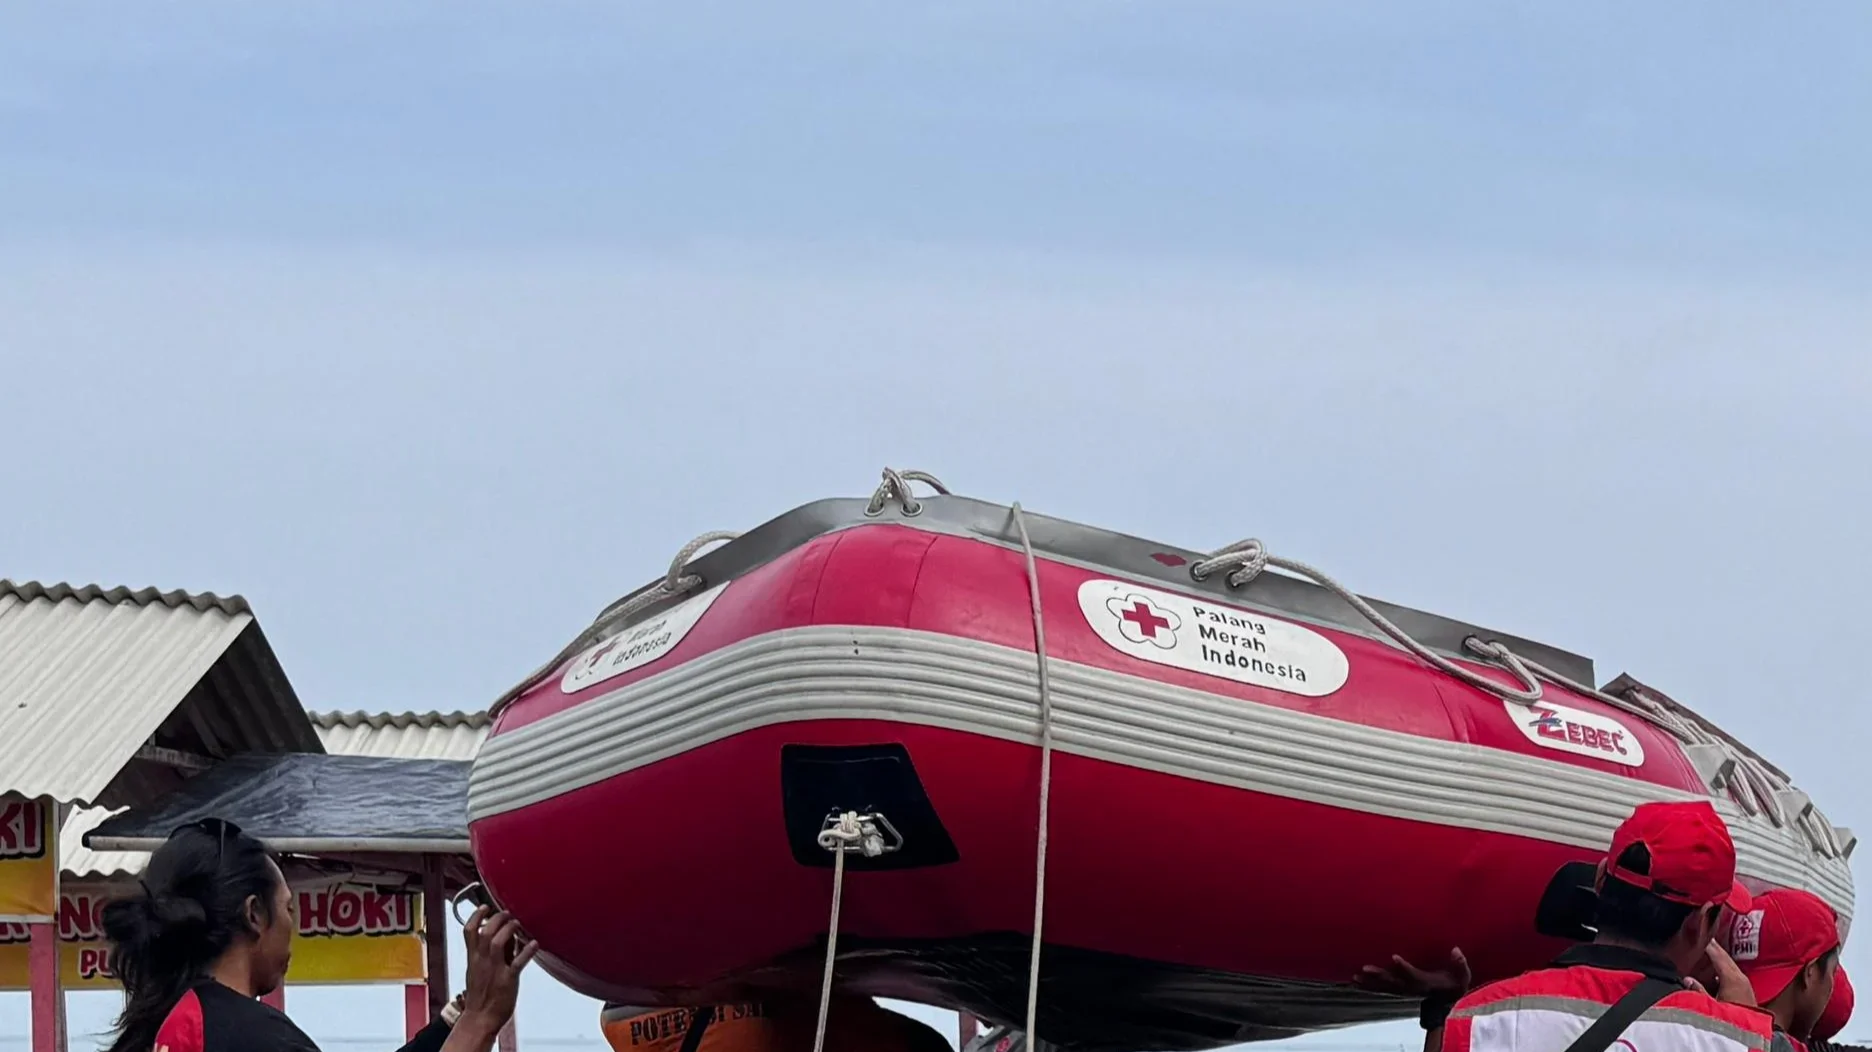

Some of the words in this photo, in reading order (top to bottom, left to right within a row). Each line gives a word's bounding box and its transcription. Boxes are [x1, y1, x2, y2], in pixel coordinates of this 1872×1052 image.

[1193, 606, 1266, 635] Palang
[1198, 624, 1266, 653] Merah
[1201, 644, 1306, 682] Indonesia
[1526, 704, 1628, 756] ZEBEC
[298, 889, 410, 934] HOKI
